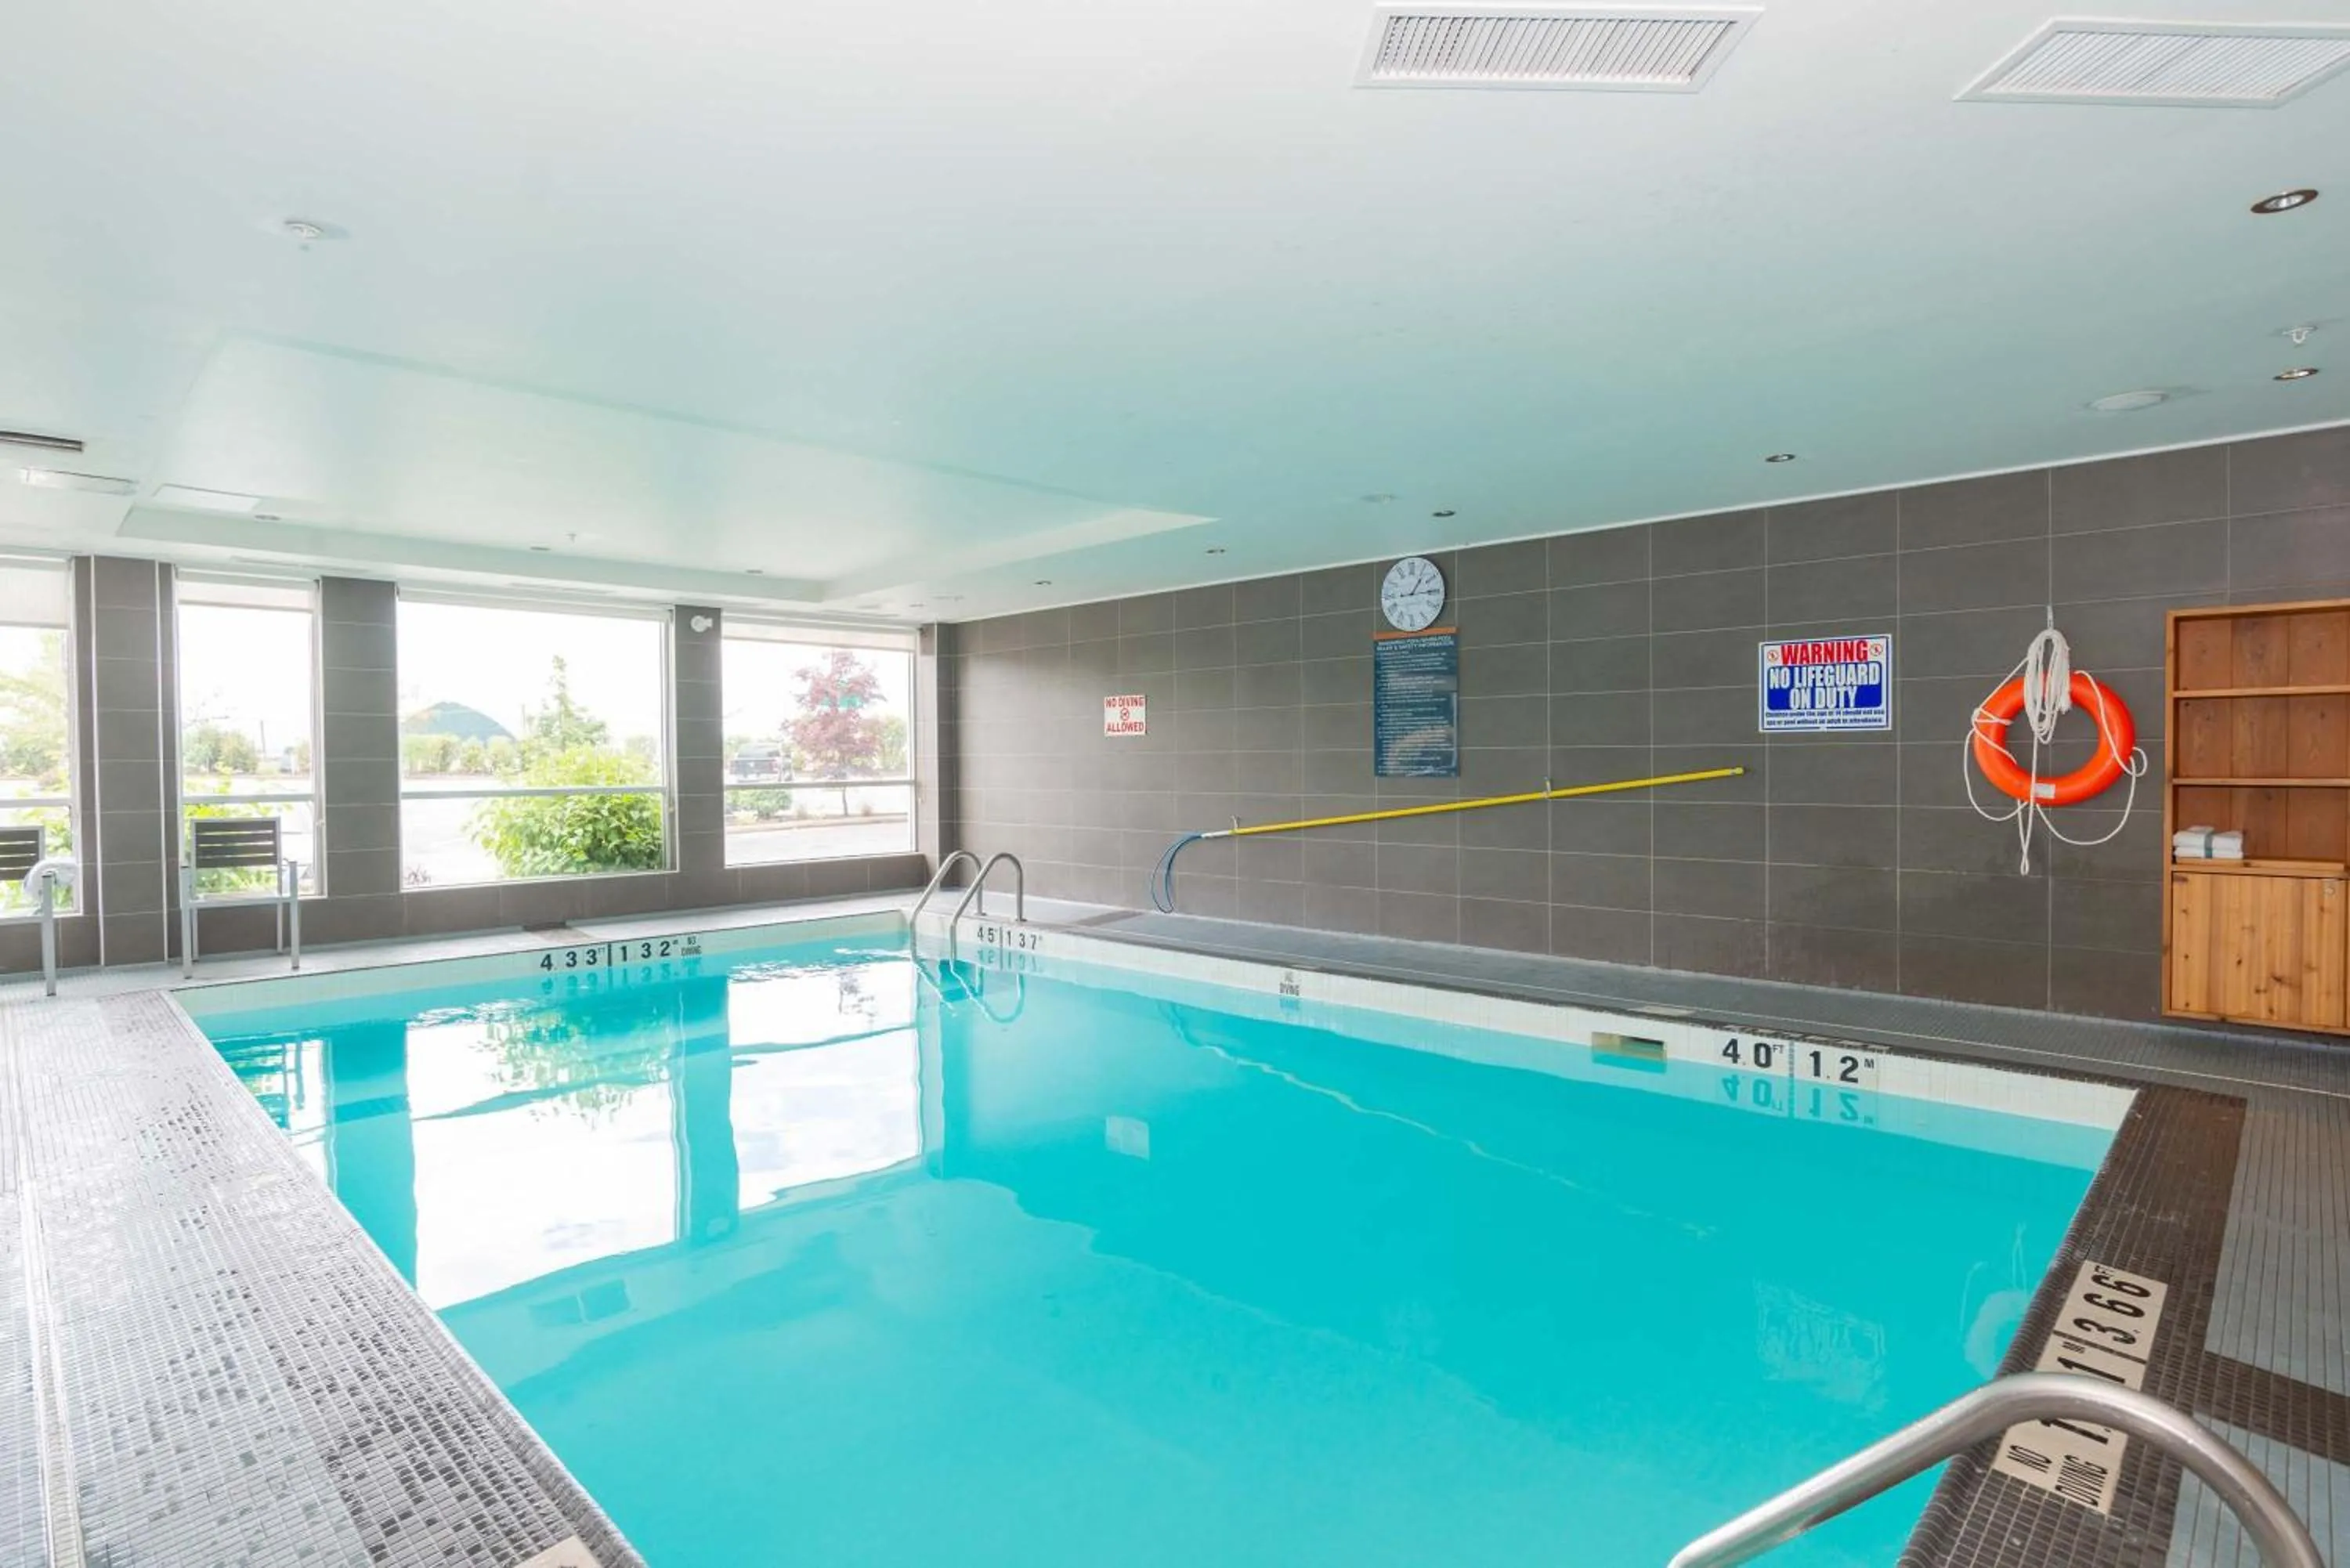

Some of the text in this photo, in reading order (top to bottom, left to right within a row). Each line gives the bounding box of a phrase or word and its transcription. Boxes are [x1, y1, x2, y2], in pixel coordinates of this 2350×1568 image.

[1781, 640, 1868, 665] WARNING
[1770, 663, 1880, 689] NO LIFEGUARD
[1106, 698, 1116, 708] NO
[1790, 686, 1857, 710] ON DUTY
[1107, 721, 1144, 732] ALLOWED
[2007, 1445, 2052, 1474] NO
[2055, 1454, 2108, 1507] DIVING
